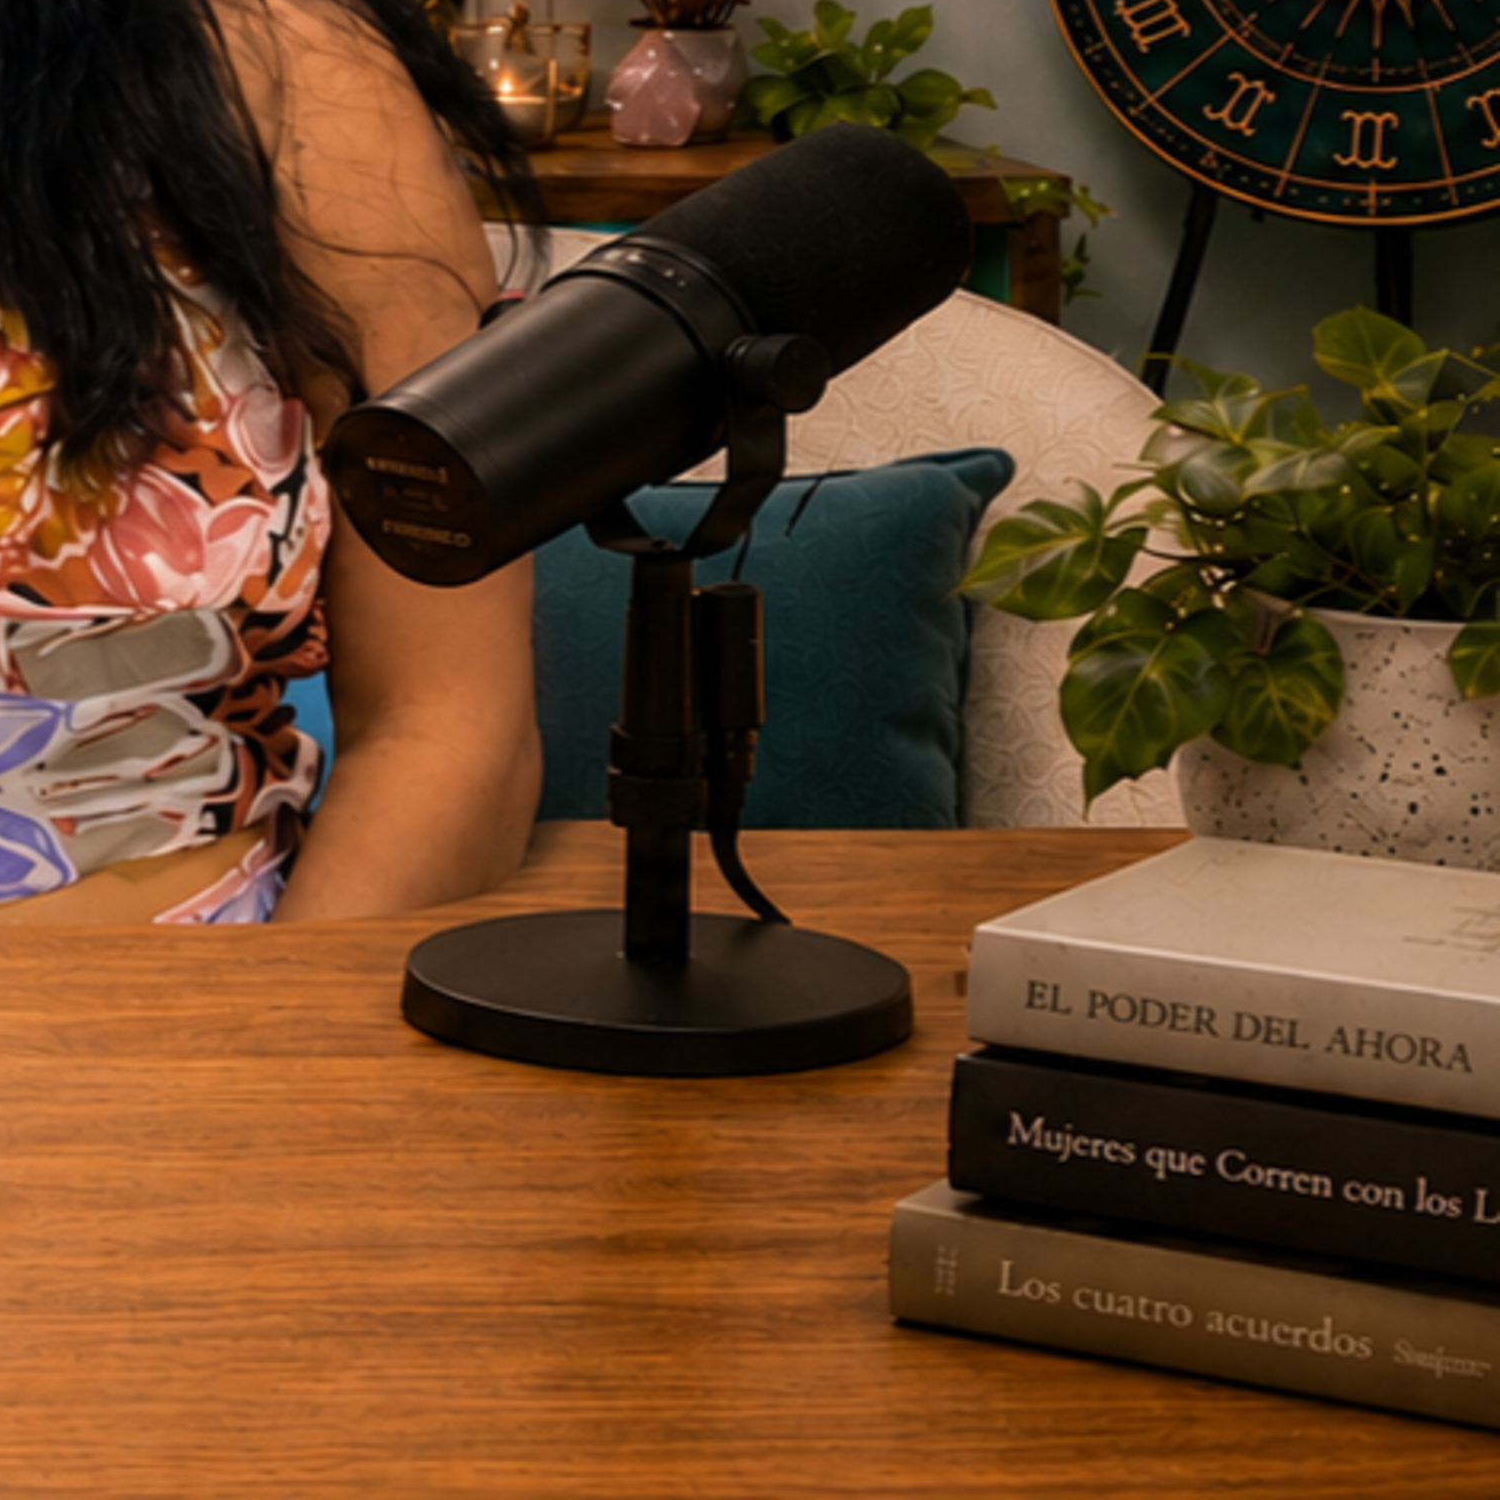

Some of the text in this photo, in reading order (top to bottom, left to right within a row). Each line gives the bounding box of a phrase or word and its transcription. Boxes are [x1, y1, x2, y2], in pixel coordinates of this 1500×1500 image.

[1025, 980, 1474, 1074] EL PODER DEL AHORA
[1007, 1111, 1137, 1164] Mujeres
[1145, 1142, 1205, 1182] que
[1215, 1148, 1333, 1199] Corren
[1342, 1180, 1405, 1211] con
[1415, 1177, 1462, 1218] los
[998, 1260, 1062, 1303] Los
[1073, 1283, 1193, 1328] cuatro
[1205, 1308, 1373, 1360] acuerdos
